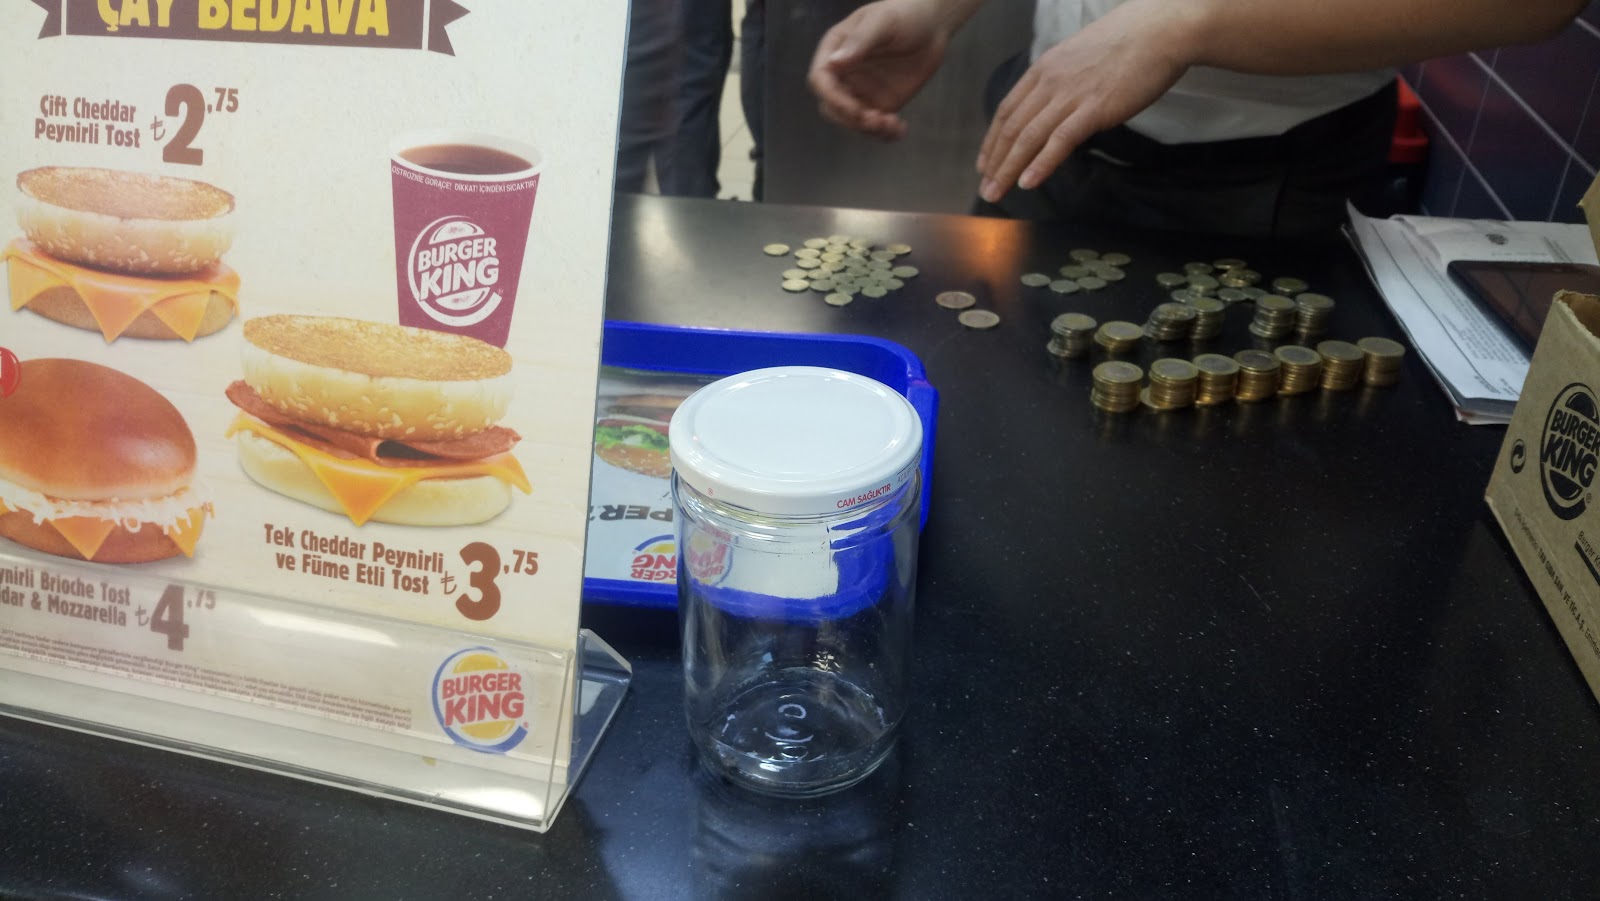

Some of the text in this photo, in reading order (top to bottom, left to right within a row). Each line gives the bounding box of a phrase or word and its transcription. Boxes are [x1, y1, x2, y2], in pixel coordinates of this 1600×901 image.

[97, 0, 389, 37] ÇAY BEDAVA
[39, 95, 136, 123] Çift Cheddar
[35, 119, 140, 148] Peynirli Tost
[418, 237, 497, 272] BURGER
[420, 257, 499, 300] KING
[1551, 409, 1600, 457] BURGER
[1543, 433, 1598, 488] KING
[600, 504, 673, 522] PER
[837, 497, 856, 509] CAM
[264, 523, 444, 573] Tek Cheddar Peynirli
[1578, 530, 1595, 557] Burger
[276, 552, 429, 595] ve Füme Etli Tost
[631, 554, 676, 570] NG
[0, 585, 127, 627] dar & Mozzarella
[40, 571, 95, 599] Brioche
[100, 582, 131, 606] Tost
[442, 673, 522, 699] BURGER
[445, 691, 525, 727] KING
